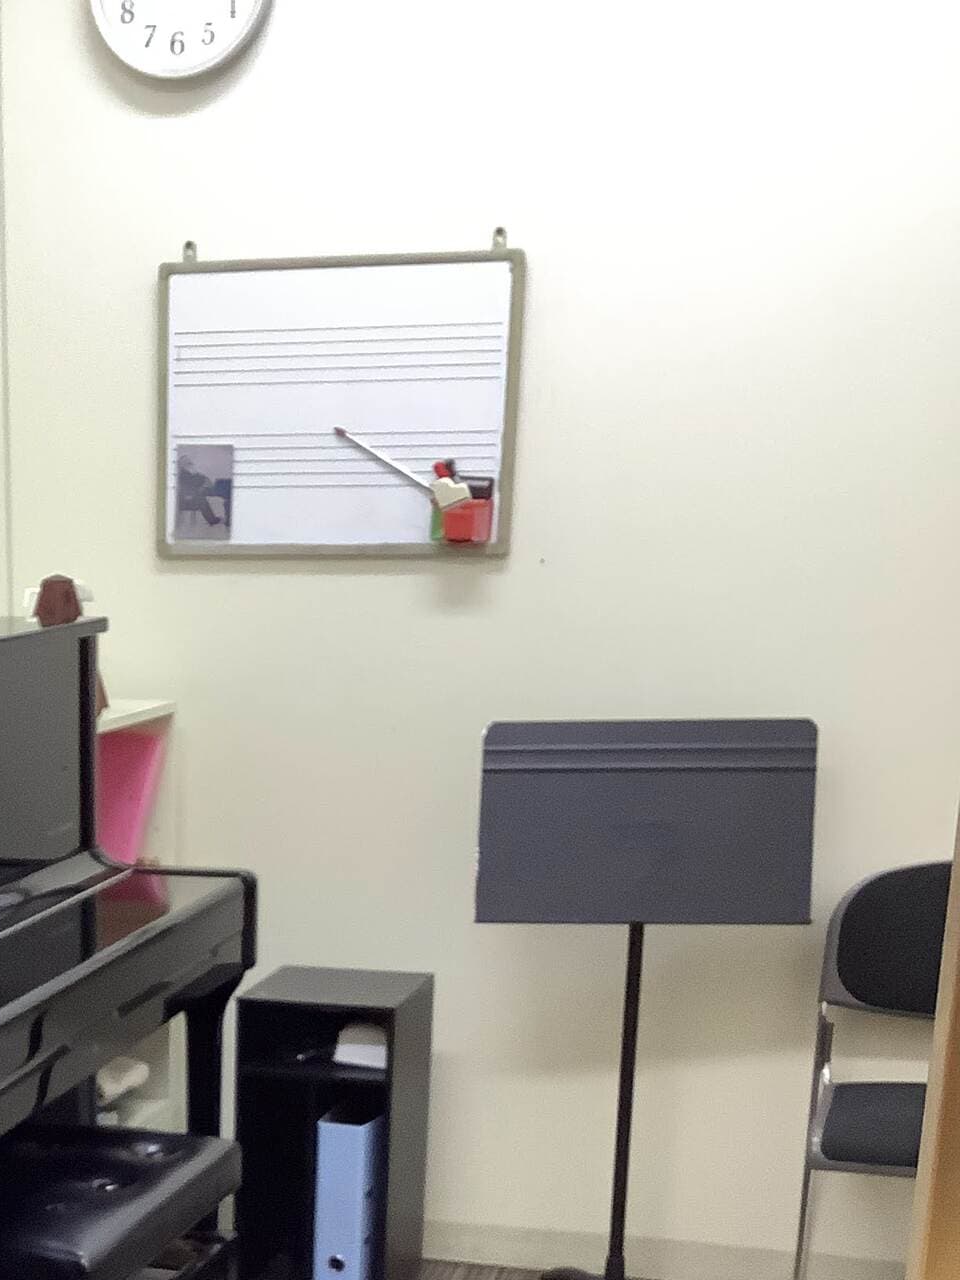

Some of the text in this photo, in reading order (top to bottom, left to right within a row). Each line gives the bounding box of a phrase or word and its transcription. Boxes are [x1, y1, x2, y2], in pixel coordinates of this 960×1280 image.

[120, 0, 135, 24] 8
[144, 24, 157, 48] 7
[169, 31, 185, 56] 6
[201, 22, 215, 46] 5
